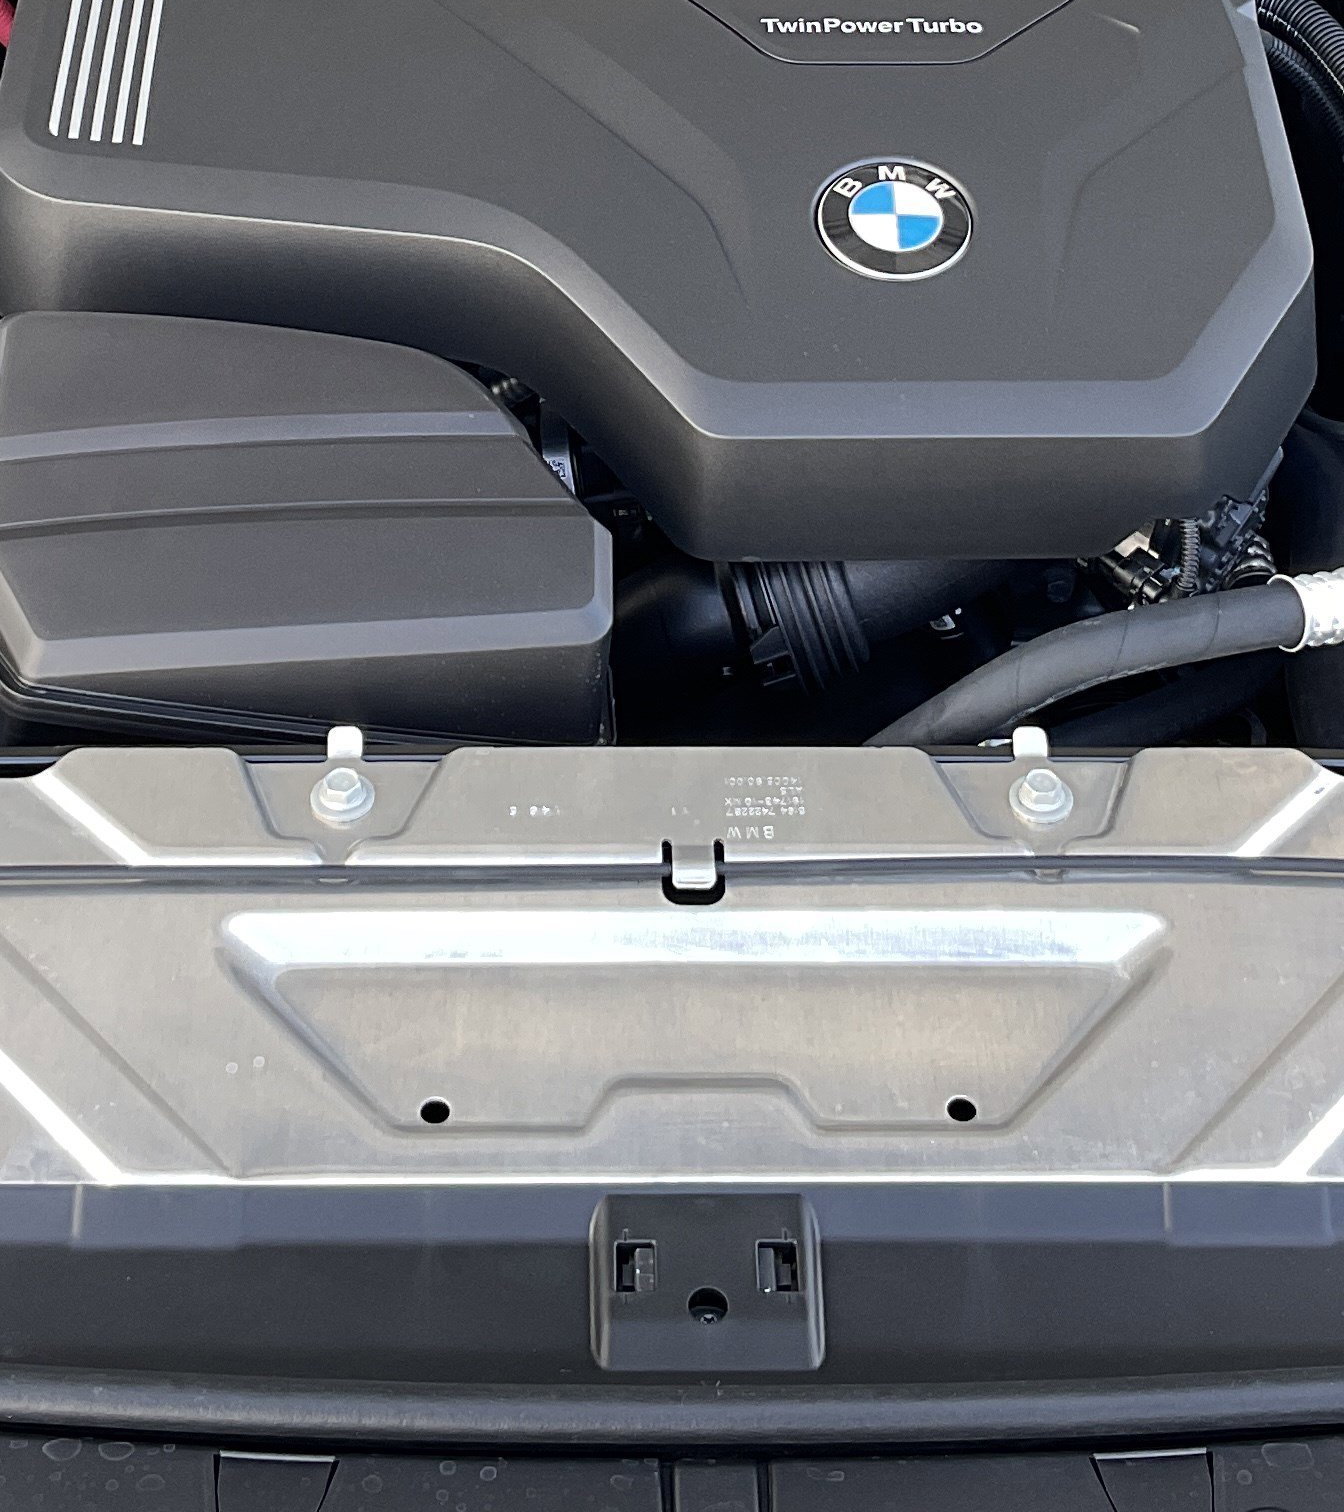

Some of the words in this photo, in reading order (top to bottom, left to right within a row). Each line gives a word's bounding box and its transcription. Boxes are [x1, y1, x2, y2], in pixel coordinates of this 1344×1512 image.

[760, 17, 903, 34] TwinPower
[906, 17, 983, 34] Turbo
[832, 165, 956, 199] BMW
[726, 825, 775, 841] BMW
